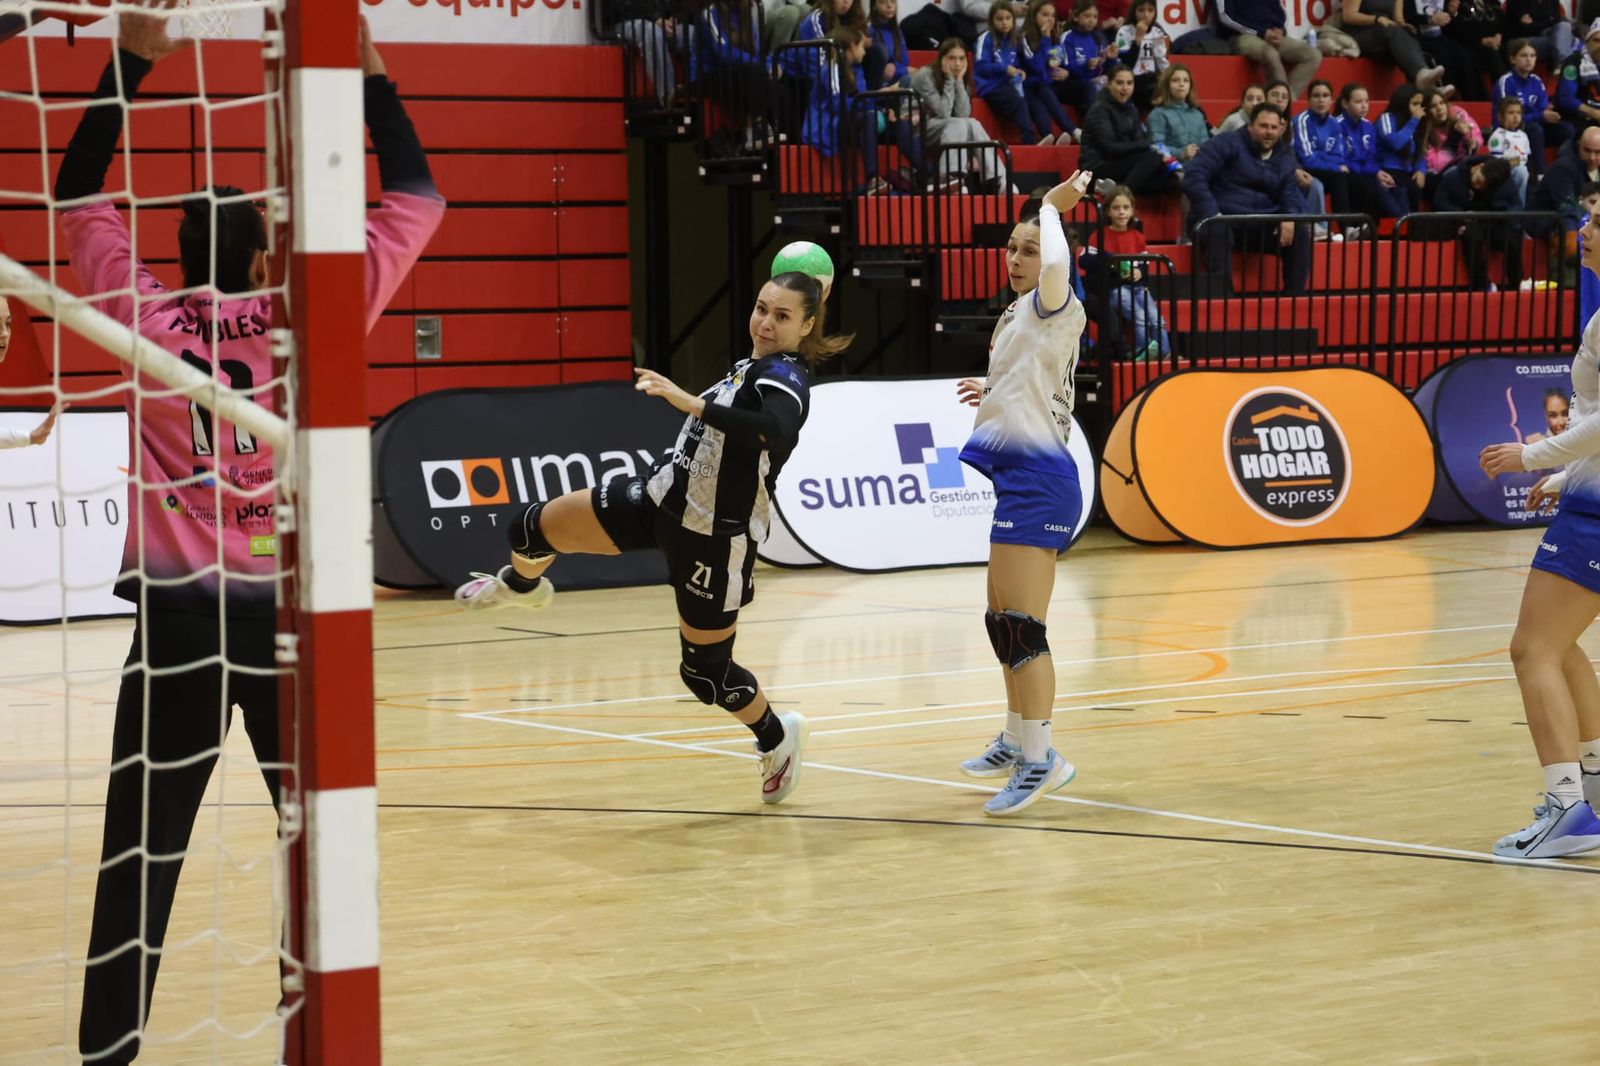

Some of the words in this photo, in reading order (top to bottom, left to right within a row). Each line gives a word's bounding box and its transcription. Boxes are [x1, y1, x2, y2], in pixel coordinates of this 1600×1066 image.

[1253, 425, 1325, 452] TODO
[1240, 451, 1331, 479] HOGAR
[798, 473, 926, 511] suma
[930, 489, 979, 503] Gestión
[1266, 489, 1335, 508] express
[1504, 485, 1518, 497] La
[1505, 499, 1518, 508] es
[1508, 510, 1536, 521] mayor
[691, 560, 712, 589] 21
